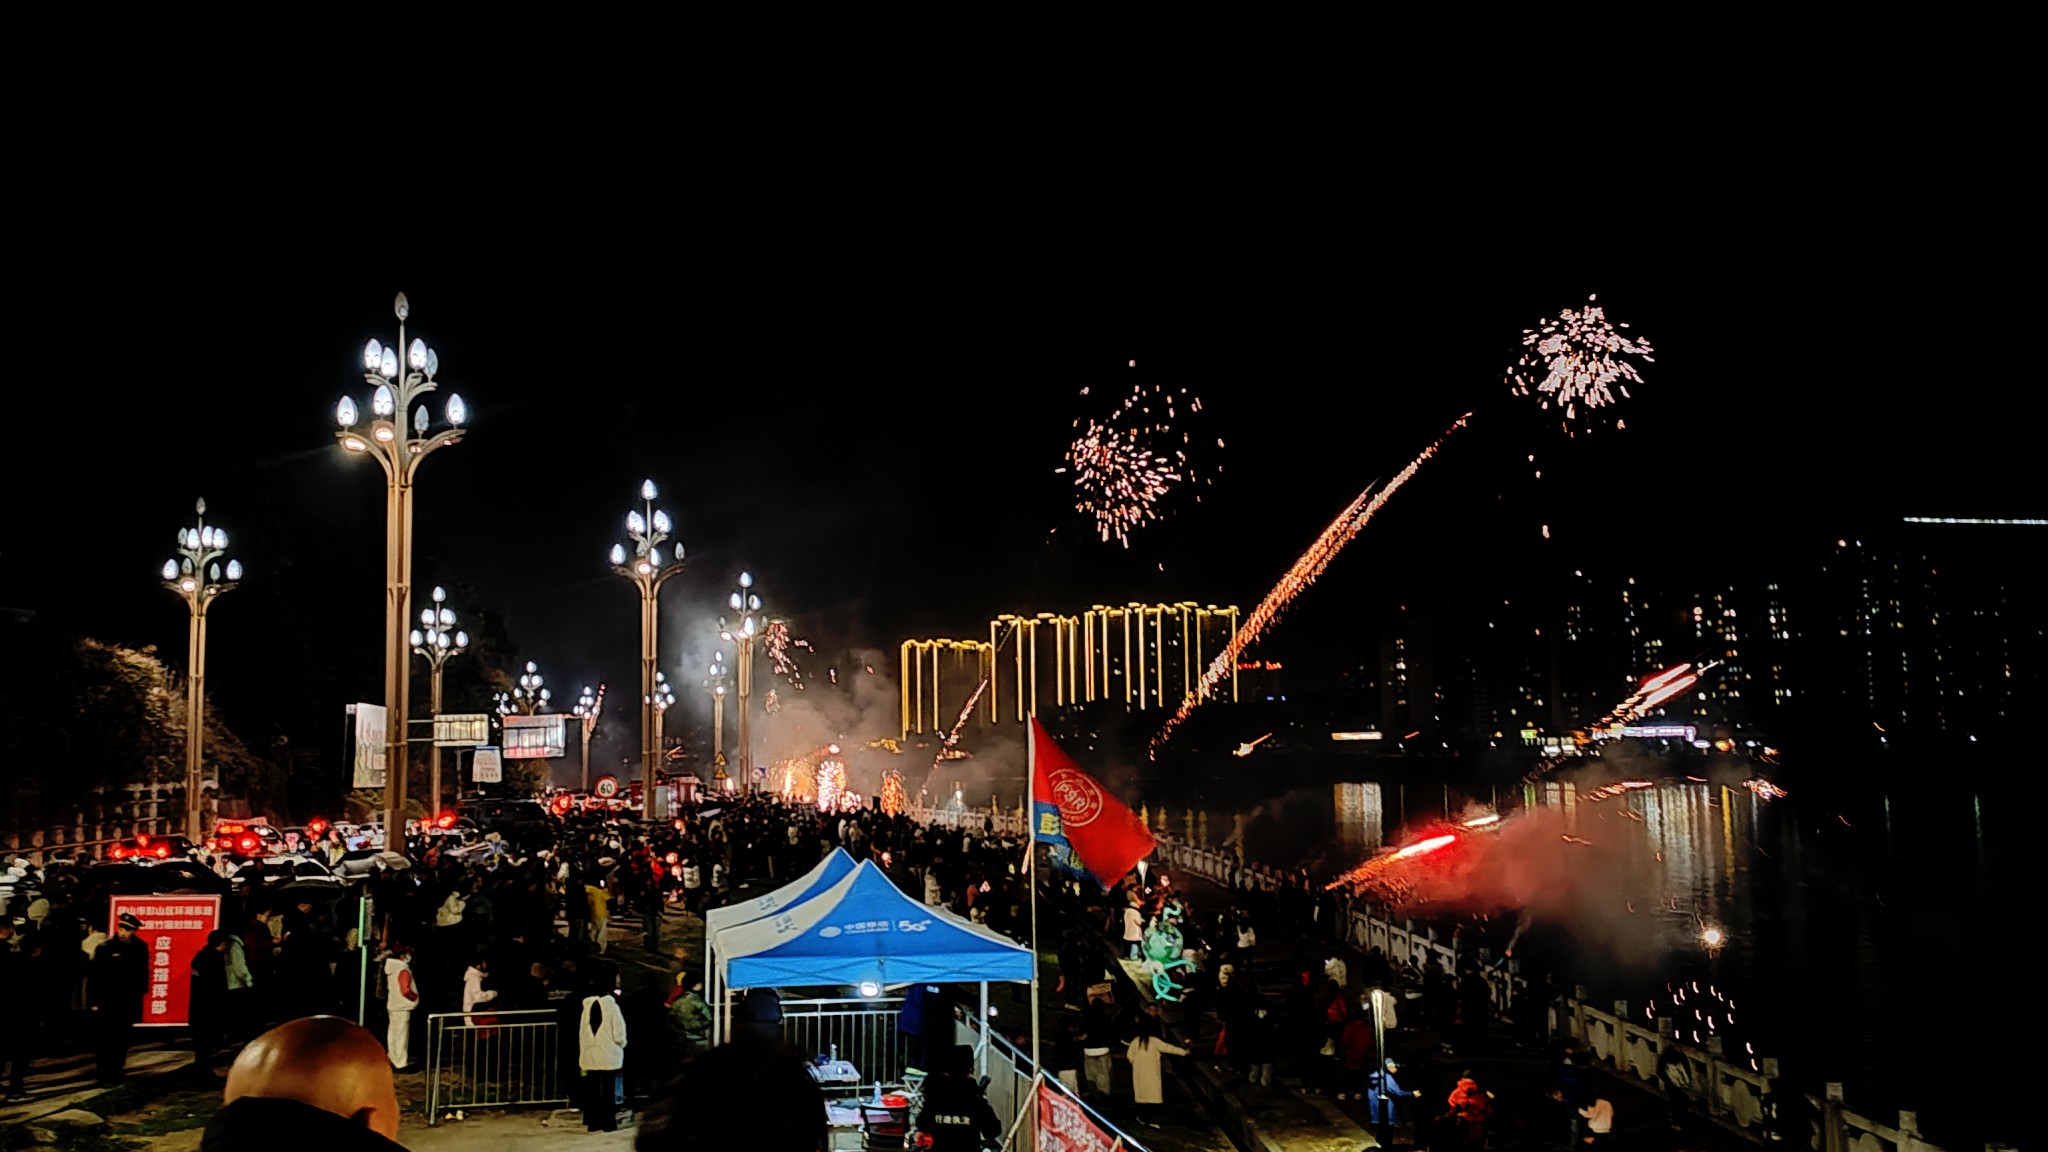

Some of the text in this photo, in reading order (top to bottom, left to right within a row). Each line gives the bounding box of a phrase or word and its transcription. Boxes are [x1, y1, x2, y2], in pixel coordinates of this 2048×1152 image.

[600, 782, 613, 794] 60
[151, 936, 172, 1015] 应急指挥部
